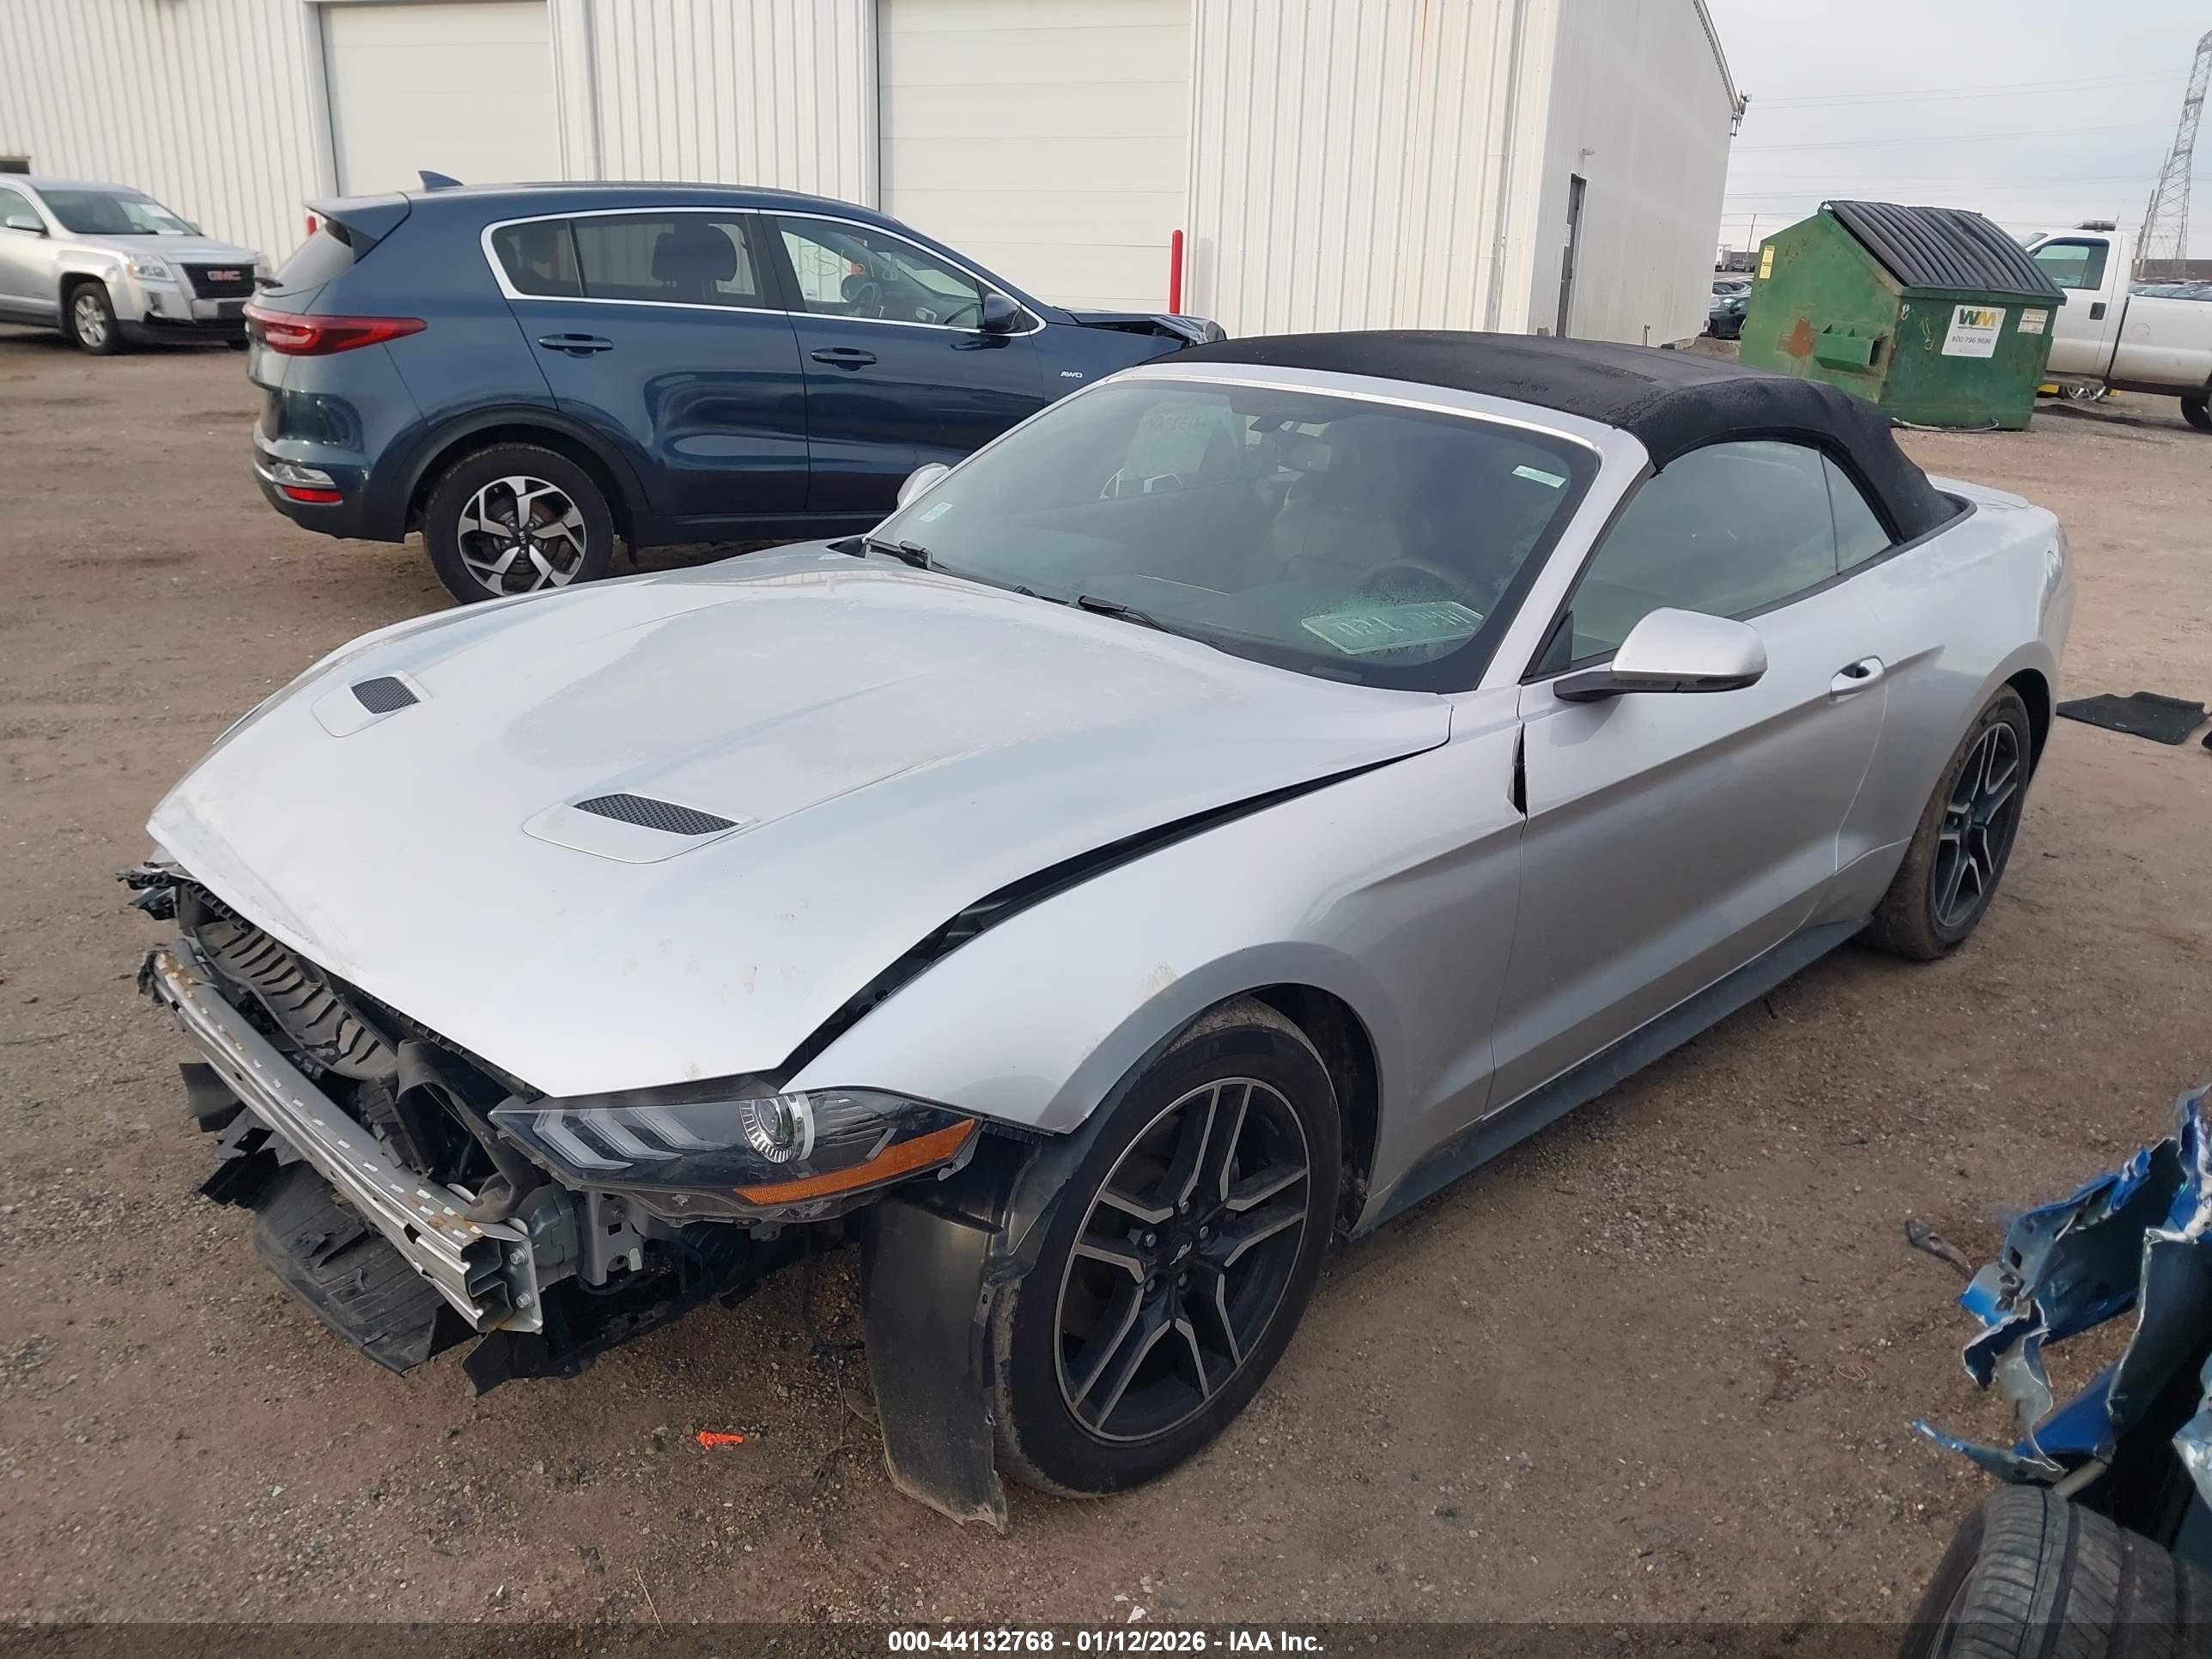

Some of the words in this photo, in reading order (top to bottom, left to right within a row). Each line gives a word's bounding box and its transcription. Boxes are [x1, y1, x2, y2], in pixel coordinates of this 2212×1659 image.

[207, 270, 241, 281] GMC
[1959, 308, 1996, 326] WM
[1951, 335, 1963, 343] 800
